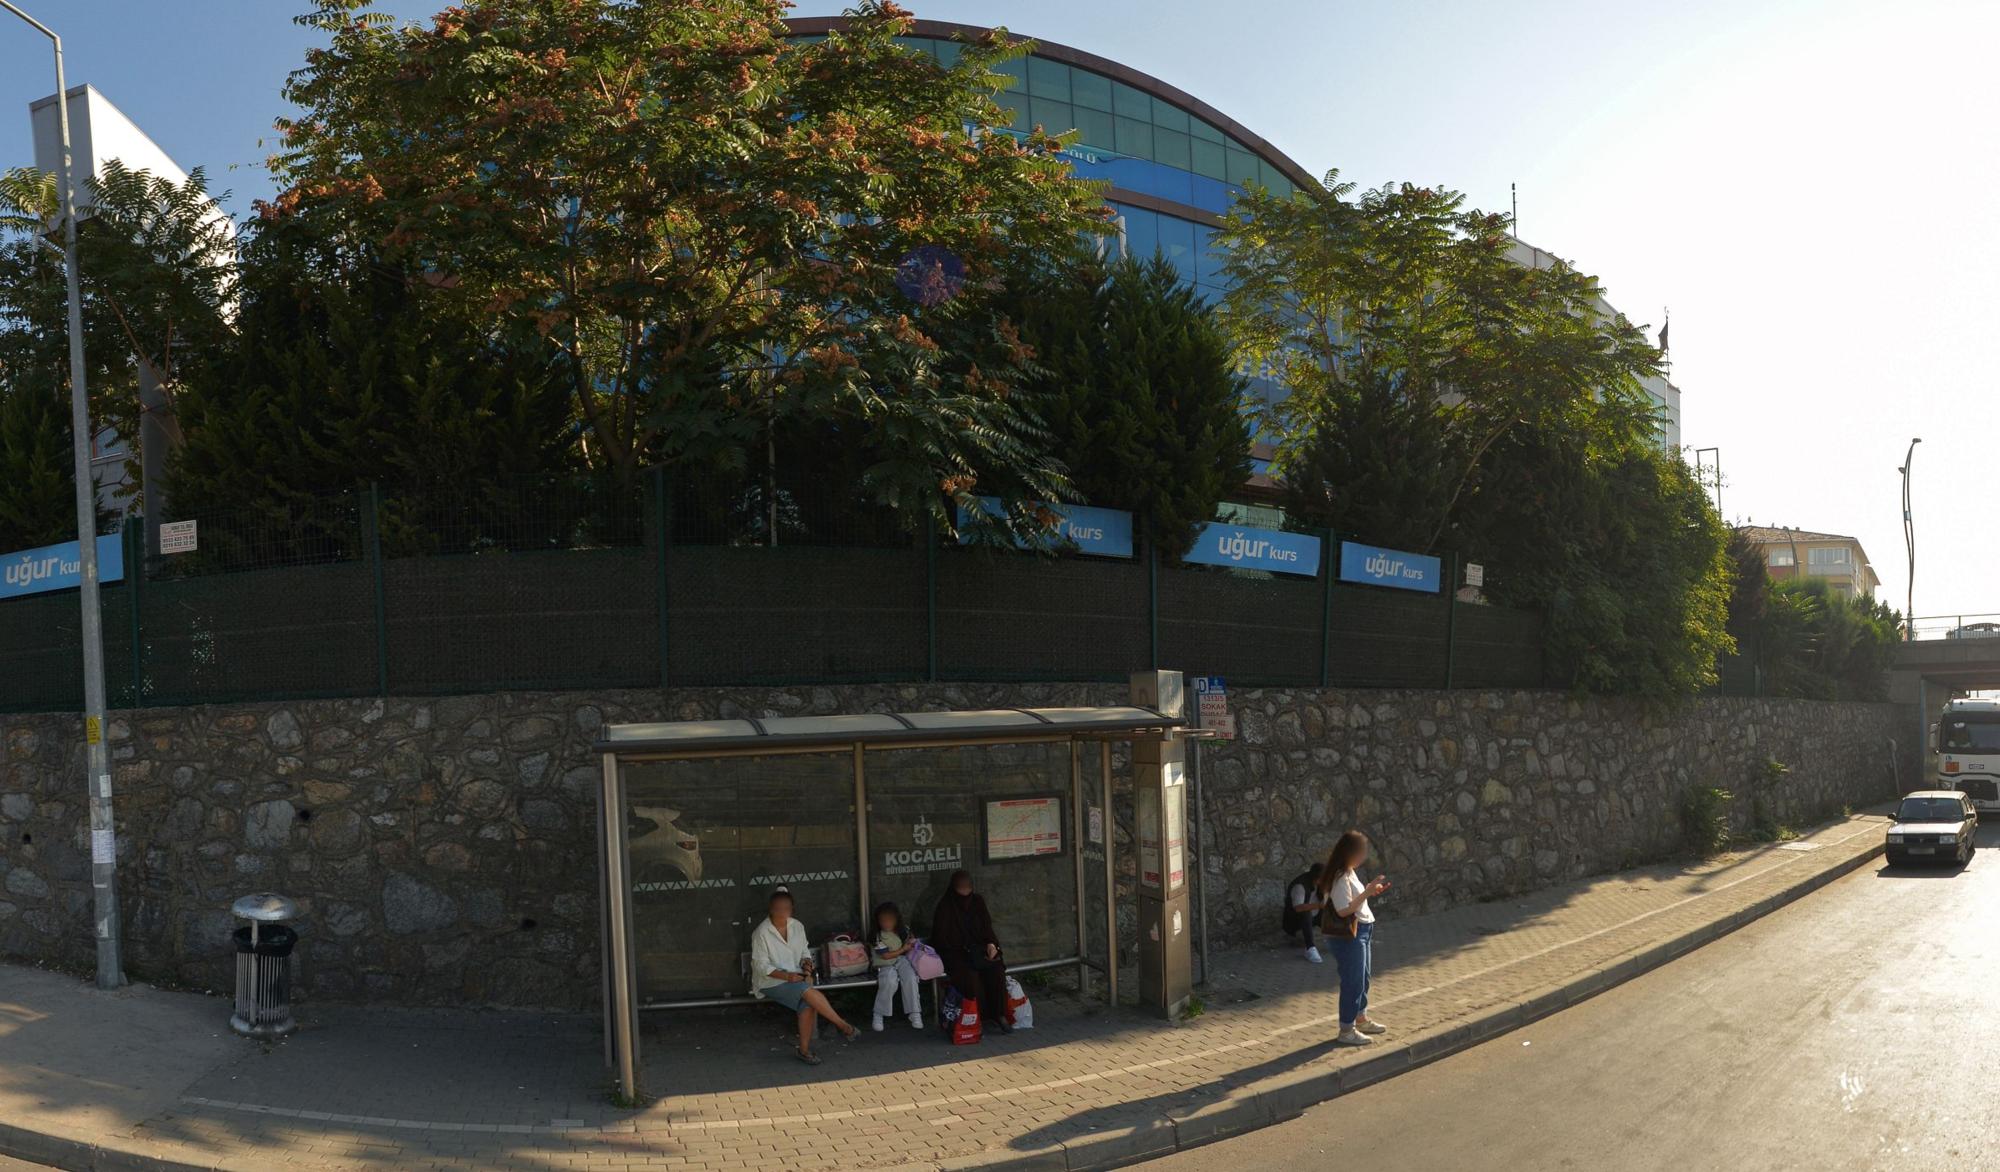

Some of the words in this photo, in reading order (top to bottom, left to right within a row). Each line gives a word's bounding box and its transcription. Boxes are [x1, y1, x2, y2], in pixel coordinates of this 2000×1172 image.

[1069, 523, 1103, 540] kurs
[1219, 532, 1269, 560] uğur
[1269, 546, 1297, 561] kurs
[6, 556, 59, 586] uğur
[60, 560, 81, 575] kur
[1365, 553, 1403, 578] uğur
[1403, 565, 1424, 580] kurs
[885, 844, 961, 865] KOCAELİ
